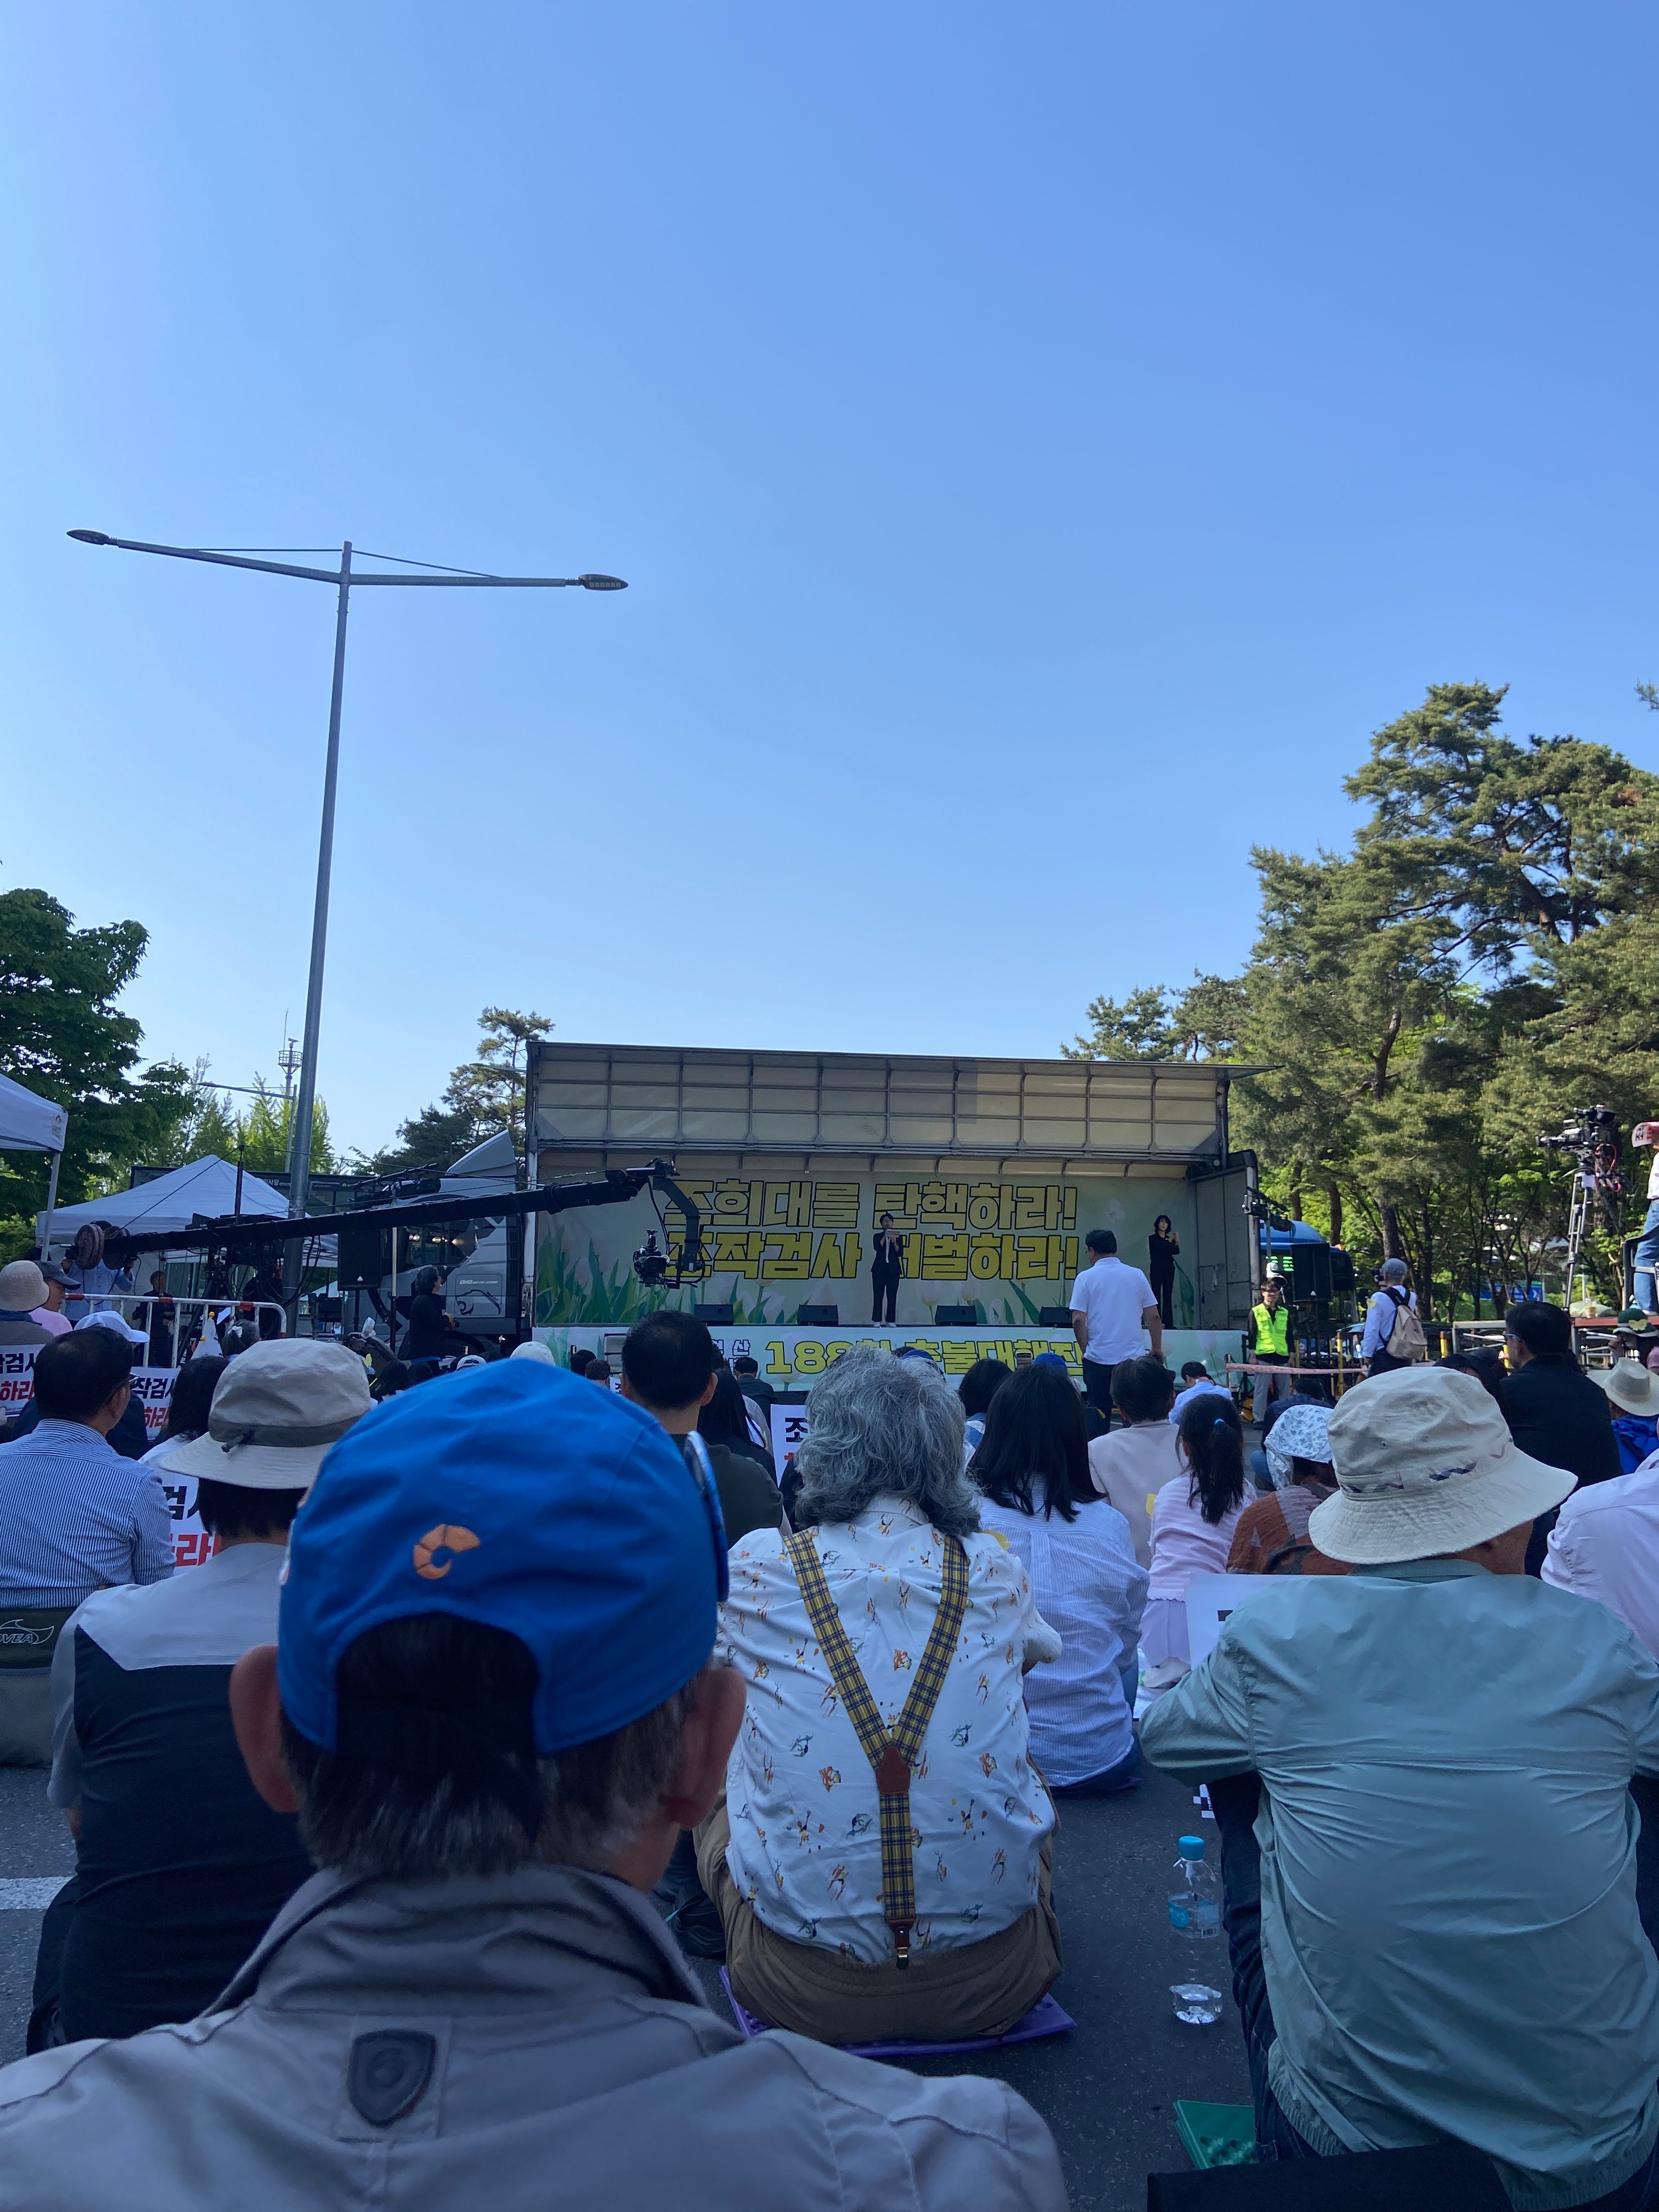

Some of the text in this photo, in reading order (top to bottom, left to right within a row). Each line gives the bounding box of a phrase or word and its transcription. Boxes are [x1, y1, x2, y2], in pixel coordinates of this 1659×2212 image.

[872, 1181, 1077, 1230] 탄핵하라!
[765, 1338, 891, 1374] 188
[0, 1633, 33, 1644] VEA
